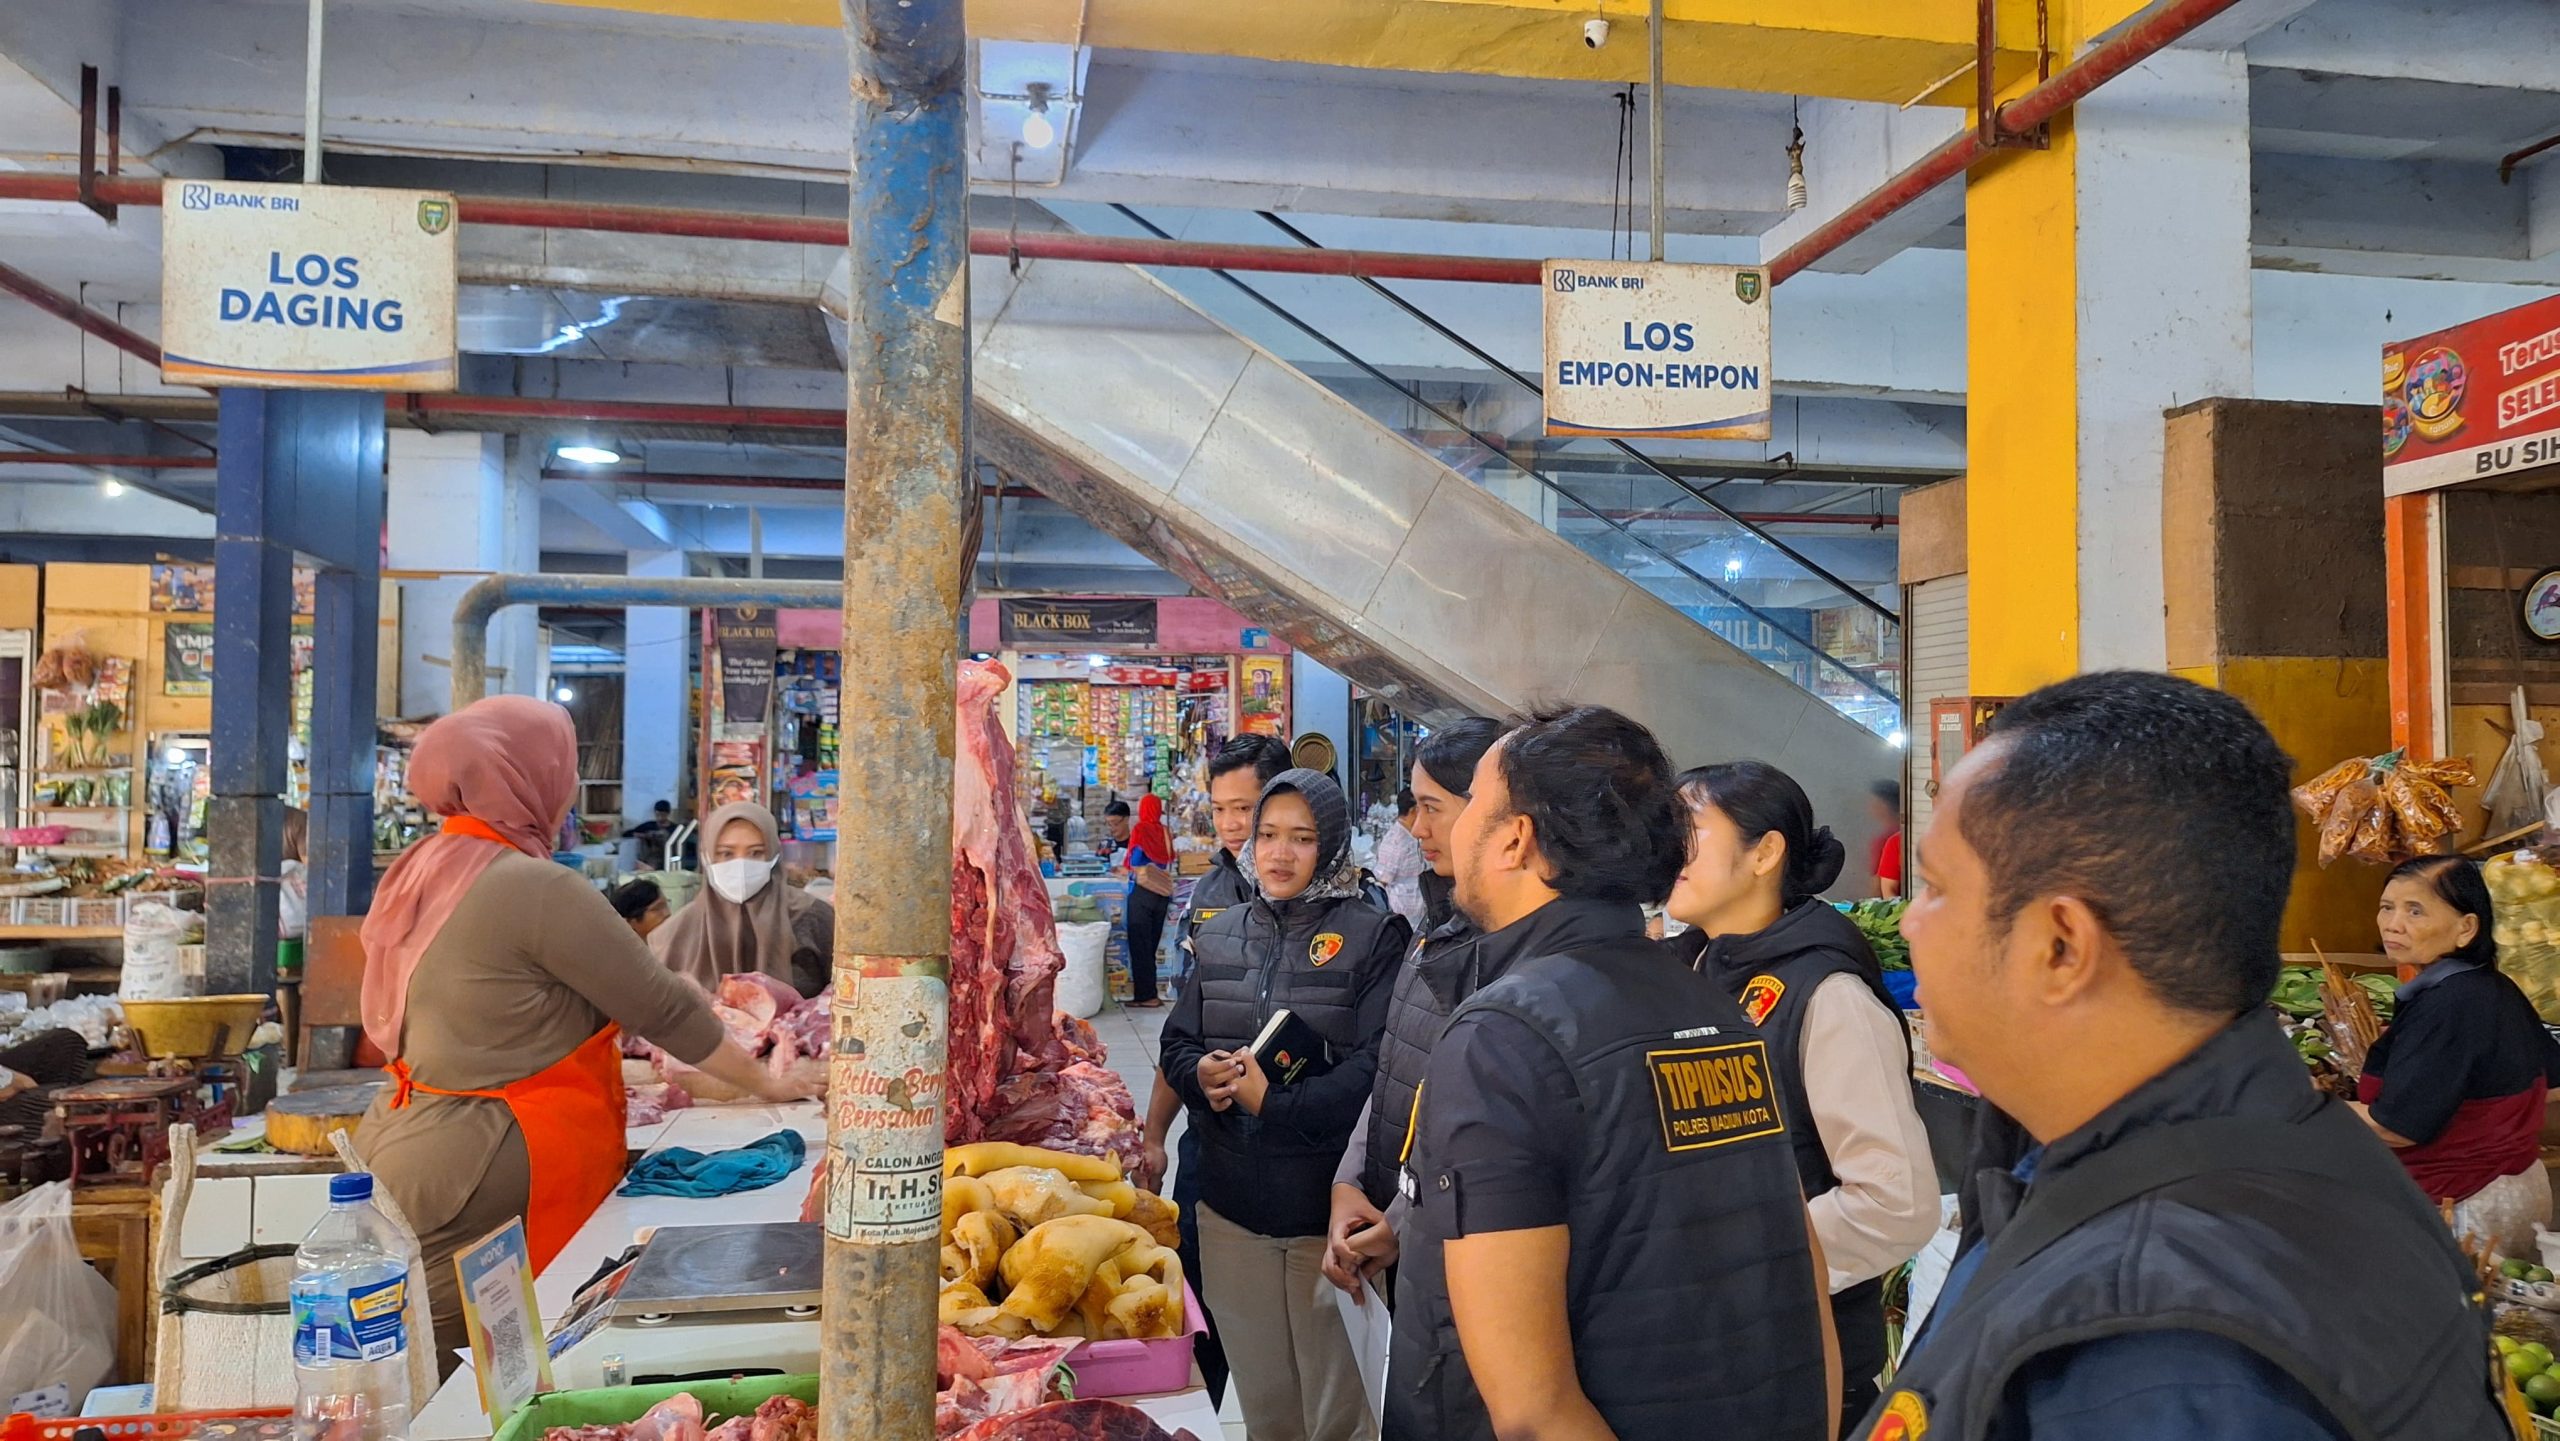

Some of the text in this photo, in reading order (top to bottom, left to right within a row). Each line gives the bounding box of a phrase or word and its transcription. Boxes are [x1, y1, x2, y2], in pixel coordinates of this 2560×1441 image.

[214, 192, 299, 212] BANK BRI
[269, 252, 360, 289] LOS
[1578, 275, 1644, 289] BANK BRI
[220, 288, 404, 332] DAGING
[1624, 321, 1694, 352] LOS
[1558, 361, 1759, 390] EMPON-EMPON
[2476, 445, 2513, 475] BU
[1014, 613, 1091, 629] BLACK BOX
[1659, 1054, 1763, 1110] TIPIDSUS
[1673, 1117, 1710, 1137] POLRES
[1743, 1107, 1772, 1126] KOTA
[865, 1156, 912, 1169] CALON
